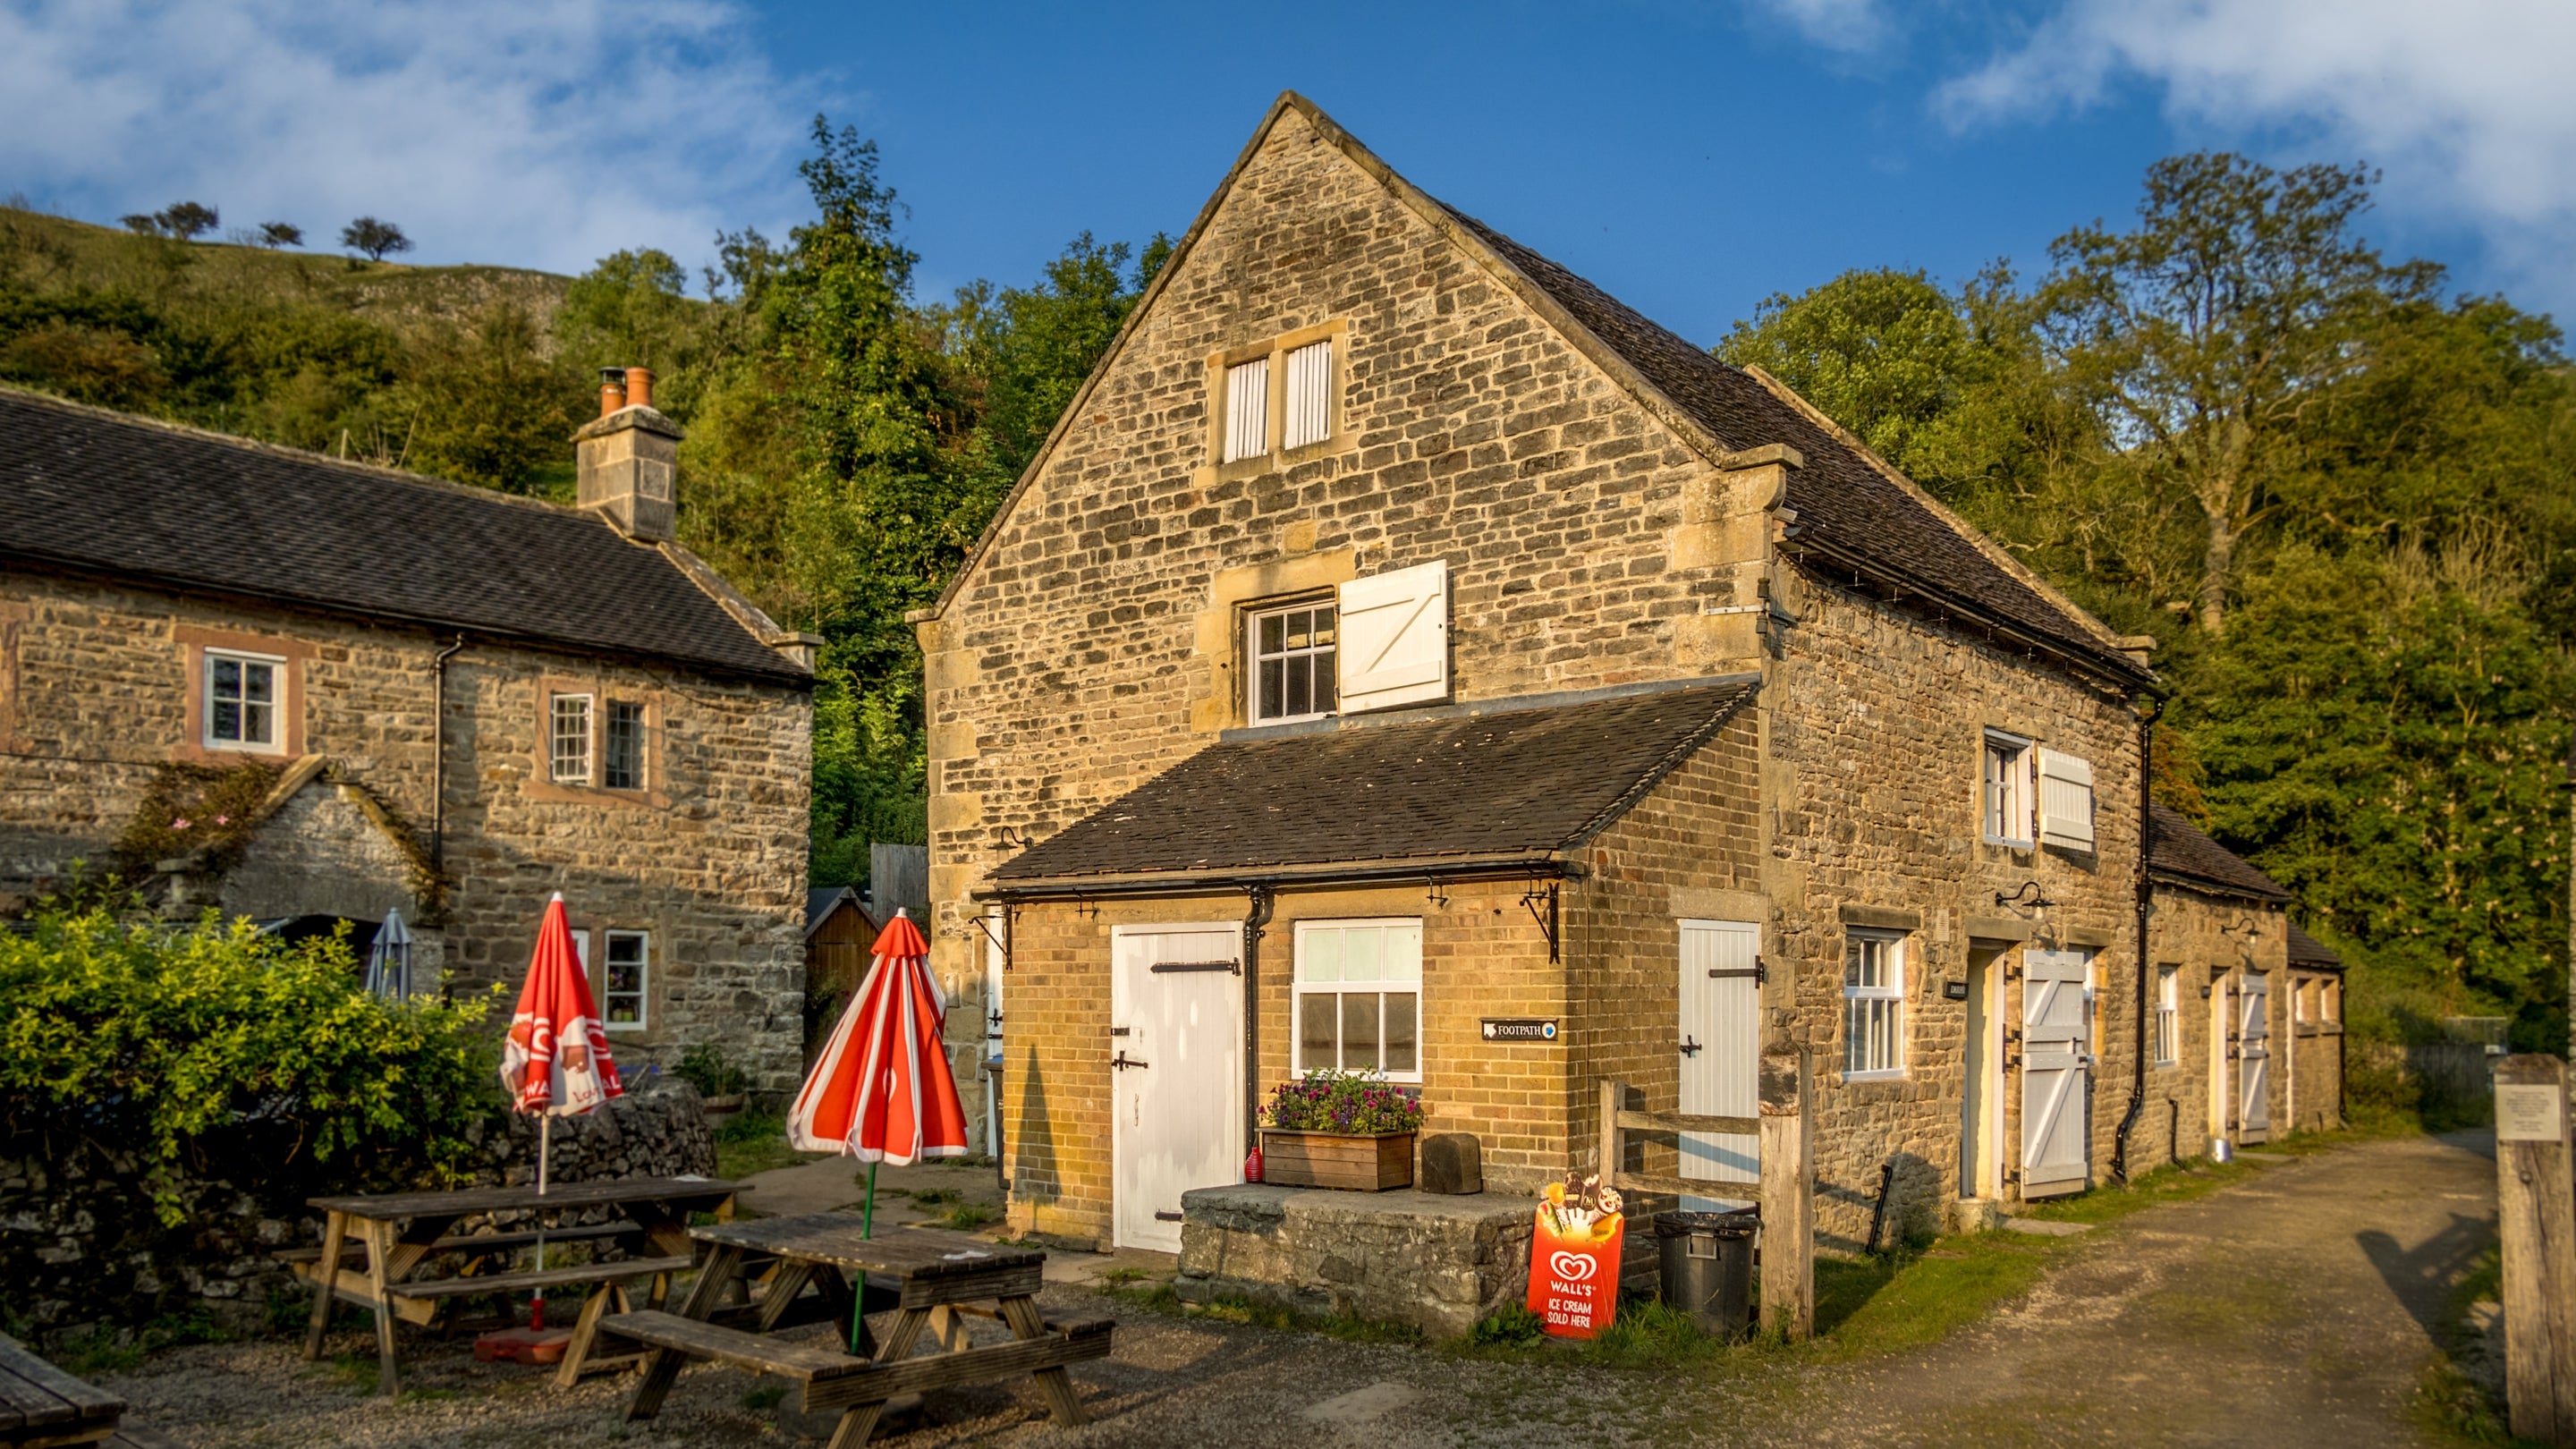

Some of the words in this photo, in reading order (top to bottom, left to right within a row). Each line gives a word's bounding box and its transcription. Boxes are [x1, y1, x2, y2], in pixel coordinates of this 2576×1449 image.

[1498, 1025, 1541, 1036] FOOTPATH
[1550, 1280, 1592, 1297] WALL'S
[1548, 1297, 1561, 1311] ICE
[1563, 1300, 1592, 1315] CREAM
[1547, 1311, 1569, 1326] SOLD
[1571, 1314, 1590, 1328] HERE
